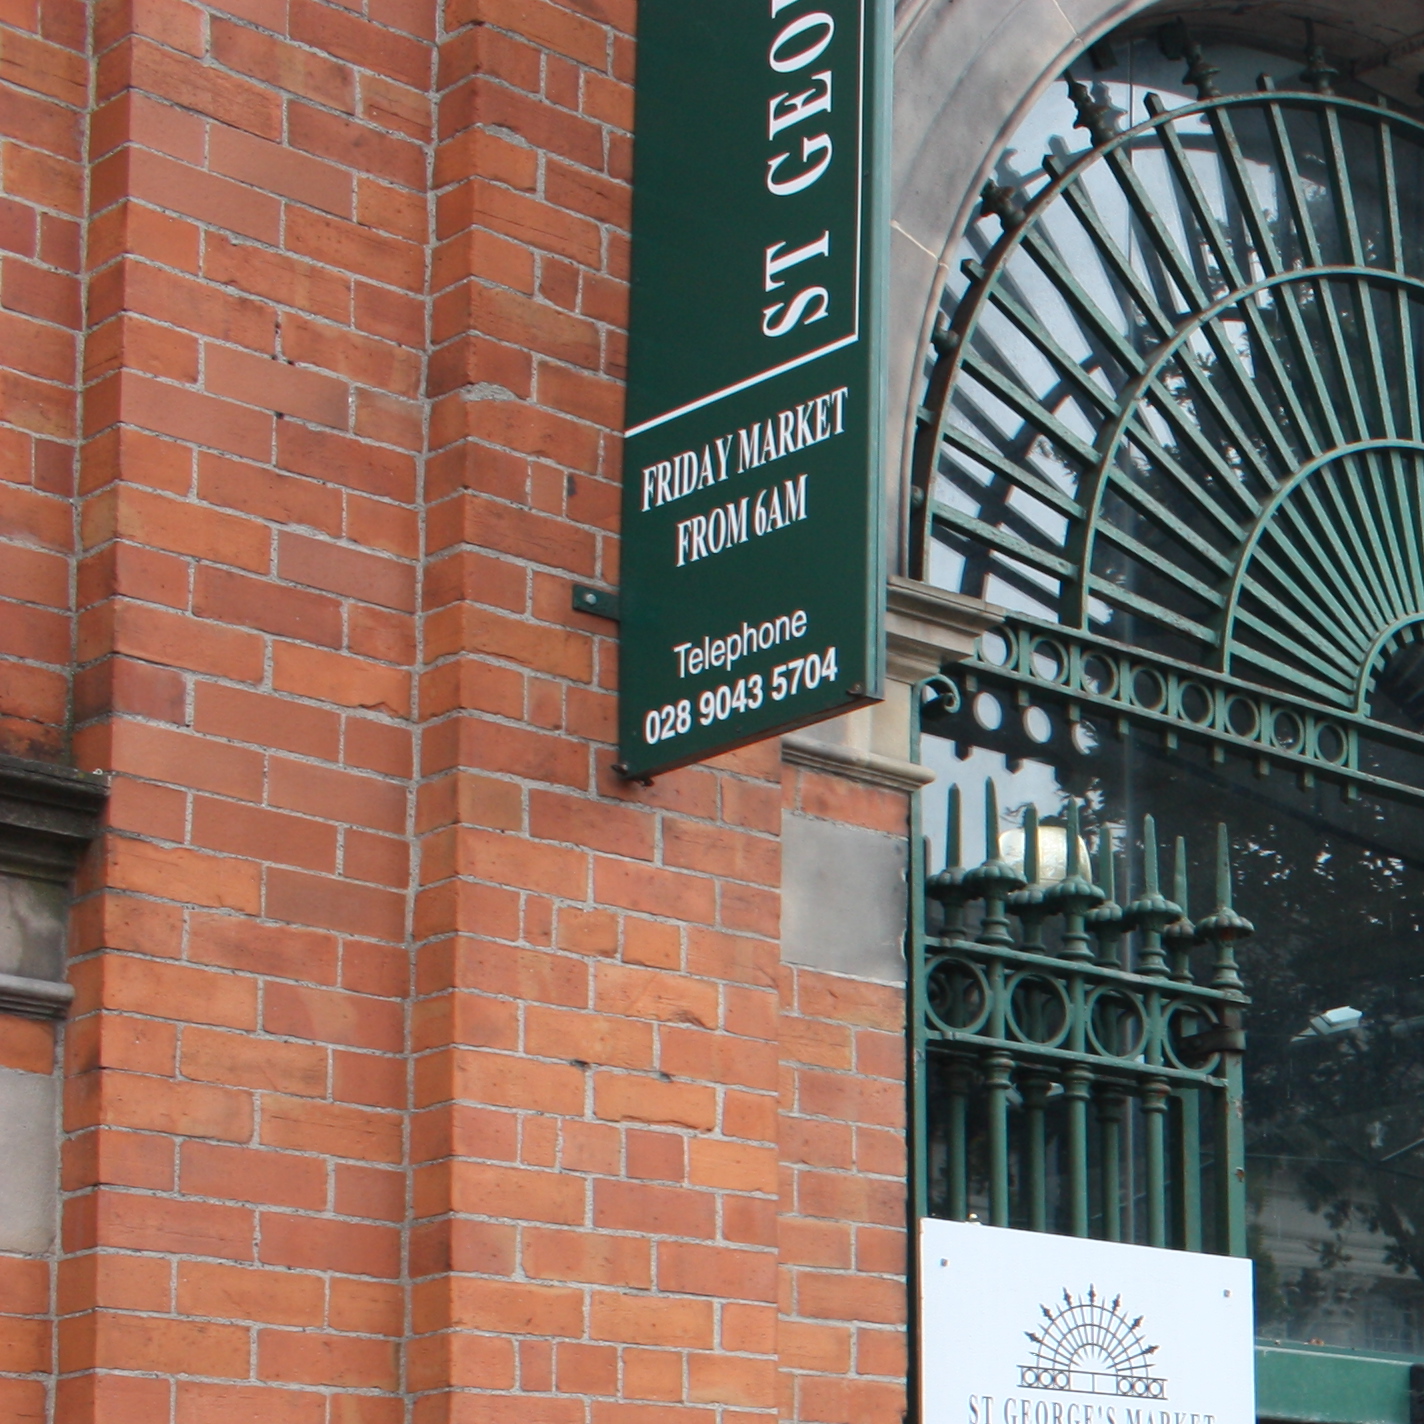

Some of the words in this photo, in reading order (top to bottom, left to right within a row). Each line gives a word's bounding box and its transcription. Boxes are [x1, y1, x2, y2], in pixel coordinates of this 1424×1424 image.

[766, 0, 835, 196] GEO
[763, 230, 830, 337] ST
[641, 434, 733, 512] FRIDAY
[737, 386, 849, 474] MARKET
[676, 497, 750, 567] FROM
[754, 474, 808, 537] 6AM
[674, 610, 808, 678] Telephone
[645, 699, 692, 744] 028
[700, 674, 763, 725] 9043
[771, 647, 838, 700] 5704
